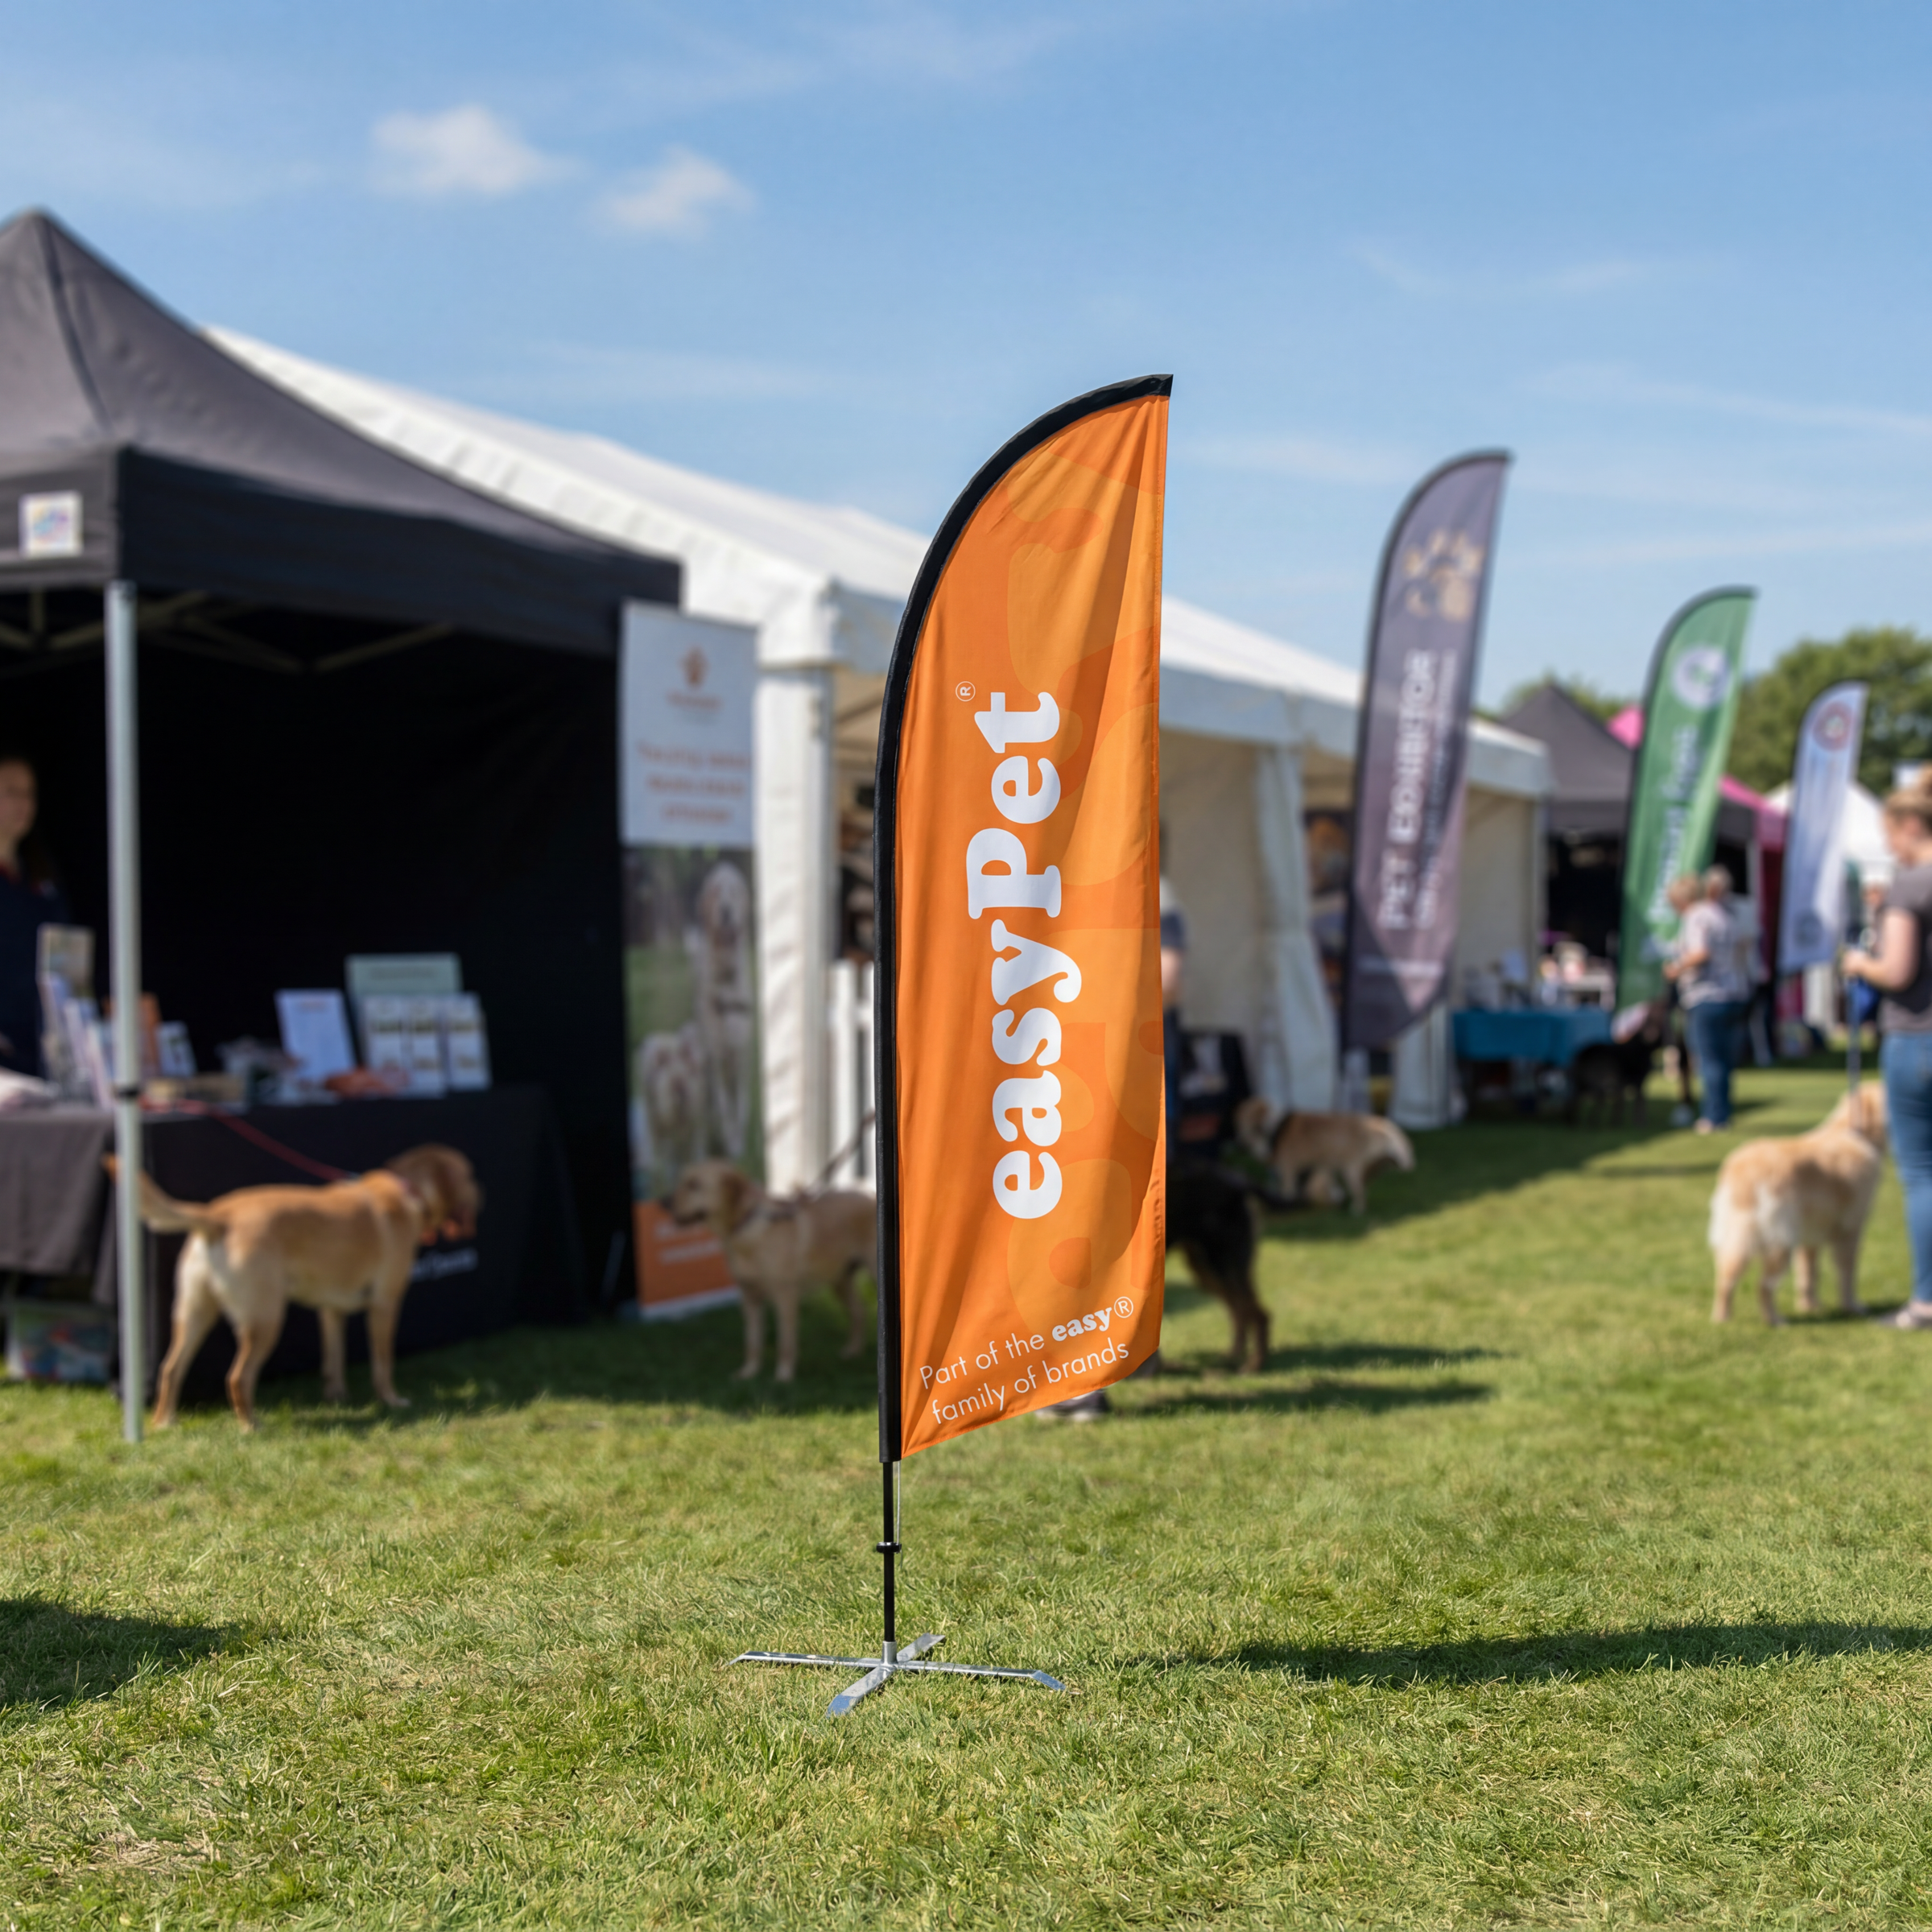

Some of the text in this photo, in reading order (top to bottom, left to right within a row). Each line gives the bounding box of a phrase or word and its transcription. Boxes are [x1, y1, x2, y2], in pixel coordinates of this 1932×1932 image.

[919, 1356, 968, 1389] Part
[976, 1340, 999, 1370] of
[1005, 1332, 1045, 1359] the
[931, 1336, 1129, 1425] family of brands
